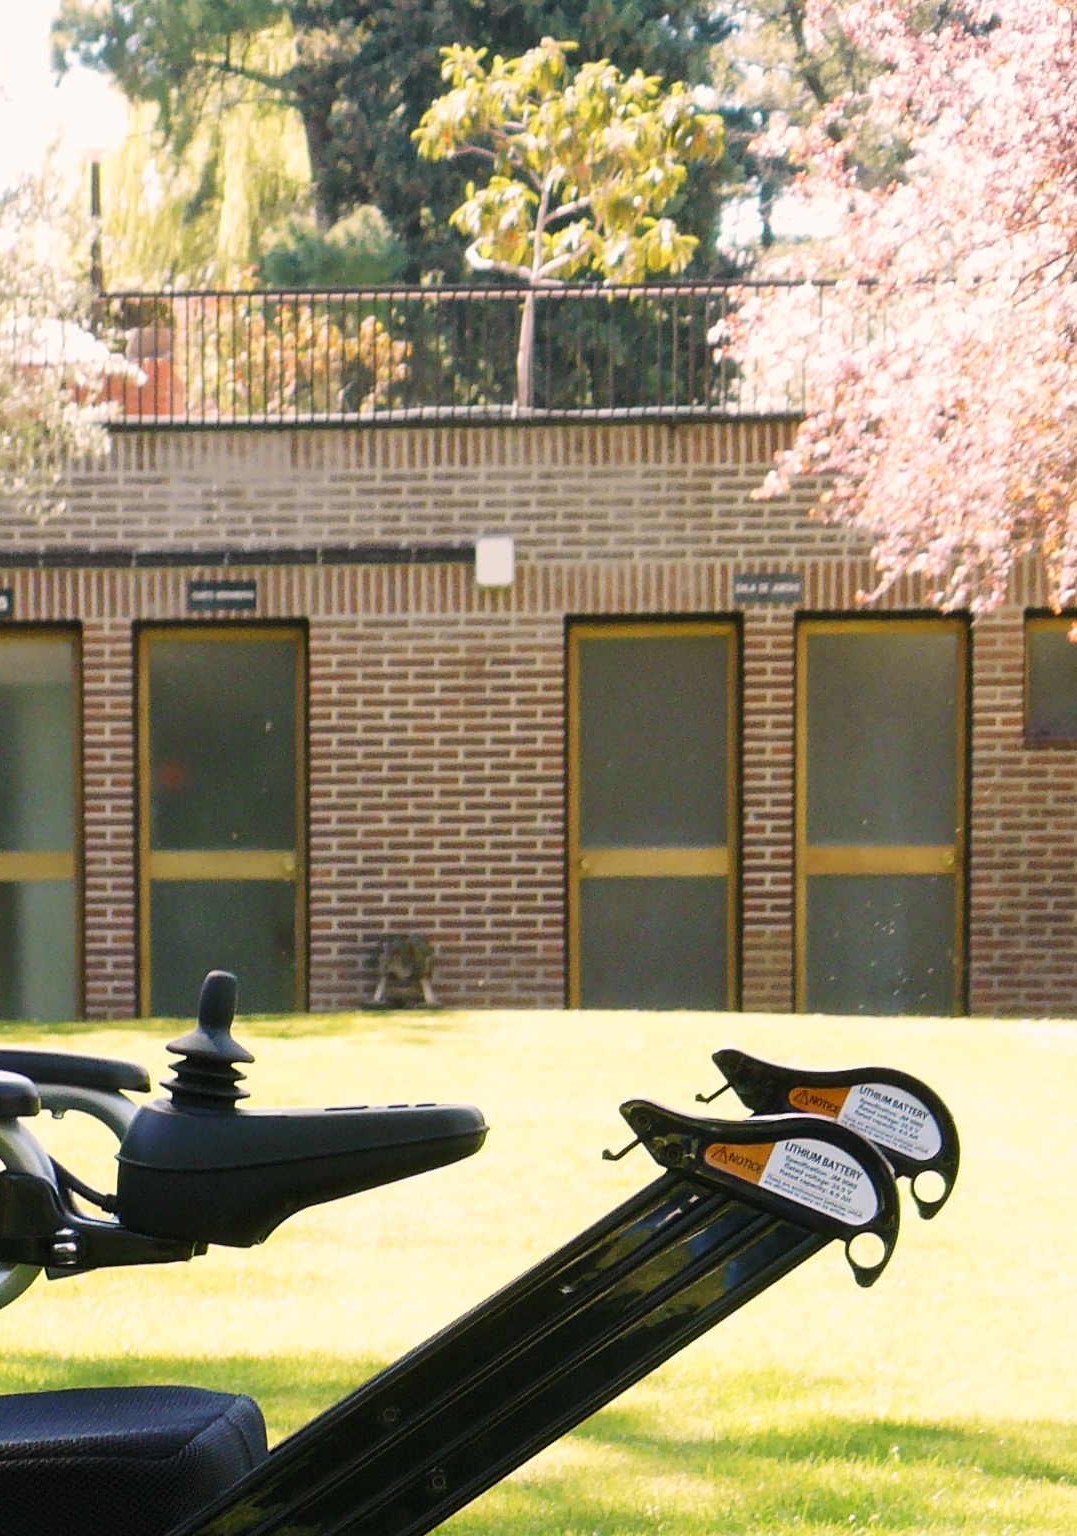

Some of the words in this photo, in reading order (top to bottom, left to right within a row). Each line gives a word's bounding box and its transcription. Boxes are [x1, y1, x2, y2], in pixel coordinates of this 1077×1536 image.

[808, 1095, 839, 1112] NOTICE
[858, 1085, 892, 1105] LITHIUM
[891, 1099, 928, 1121] BATTERY
[727, 1152, 762, 1173] NOTICE
[783, 1141, 822, 1164] LITHIUM
[821, 1156, 863, 1181] BATTERY
